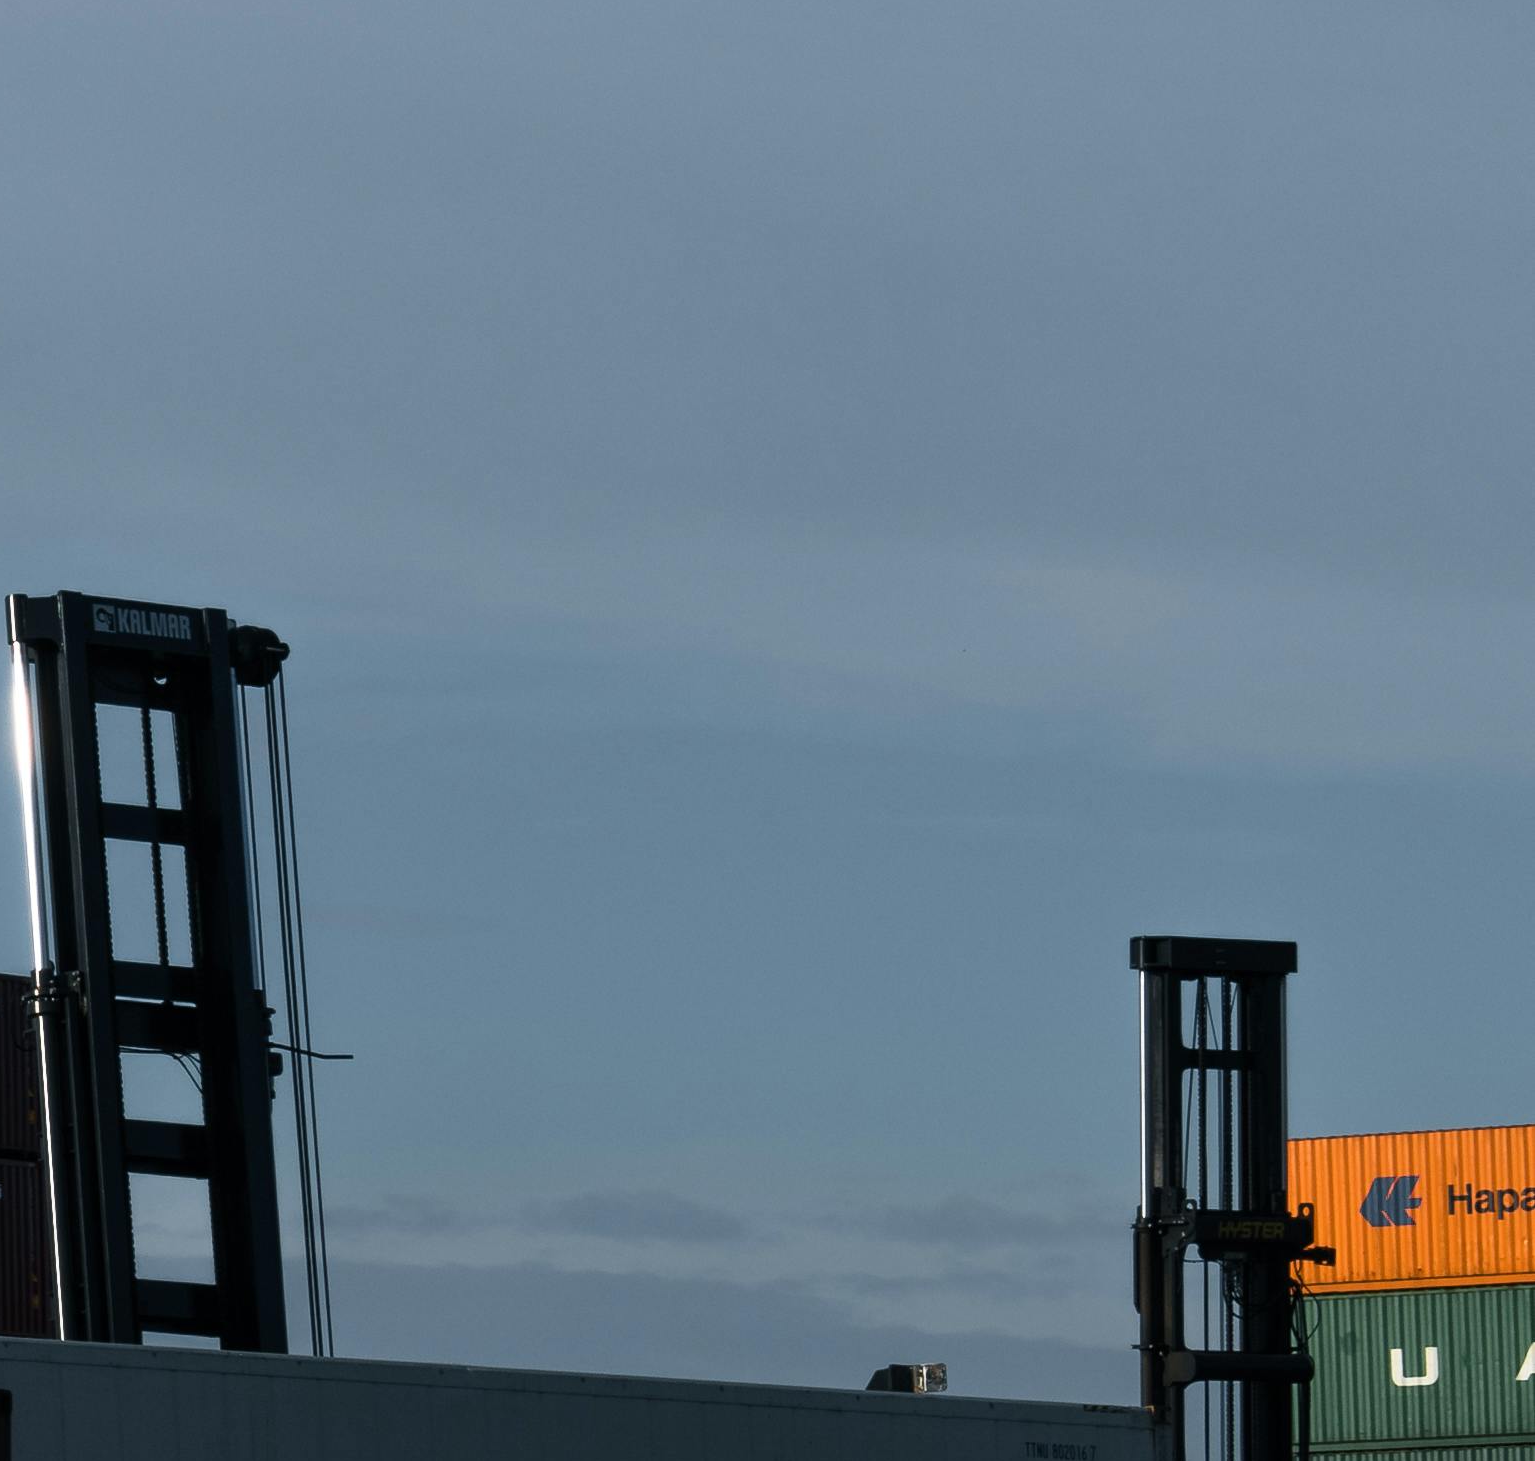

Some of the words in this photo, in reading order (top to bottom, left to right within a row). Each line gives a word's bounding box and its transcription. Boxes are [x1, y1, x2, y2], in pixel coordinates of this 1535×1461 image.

[117, 608, 192, 640] KALMAR
[1448, 1183, 1535, 1215] Hapa
[1218, 1220, 1285, 1239] HYSTER
[1025, 1442, 1048, 1458] TTNU
[1052, 1444, 1087, 1461] 802016
[1090, 1445, 1096, 1461] 7
